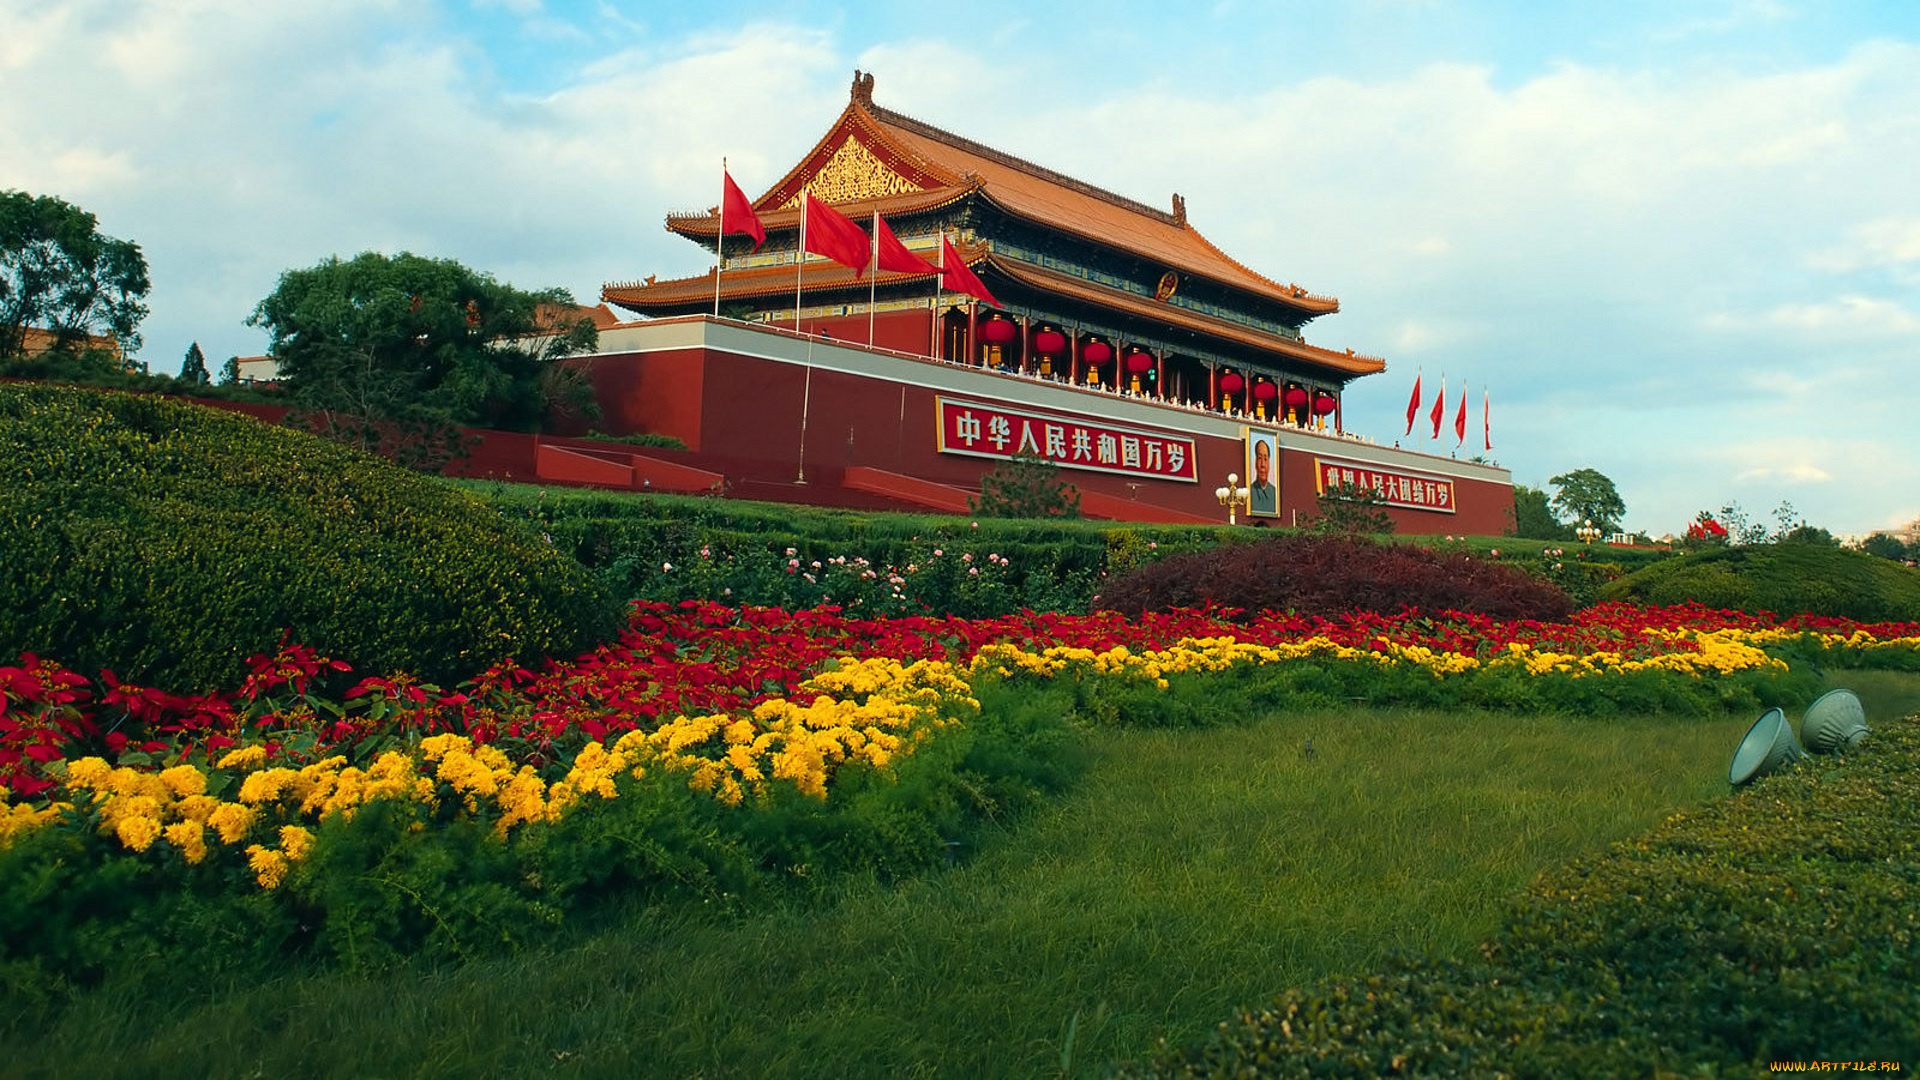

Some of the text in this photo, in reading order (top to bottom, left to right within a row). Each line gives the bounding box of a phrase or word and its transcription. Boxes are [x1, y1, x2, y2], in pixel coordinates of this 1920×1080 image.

[957, 411, 1185, 473] 中华人民共和国万岁
